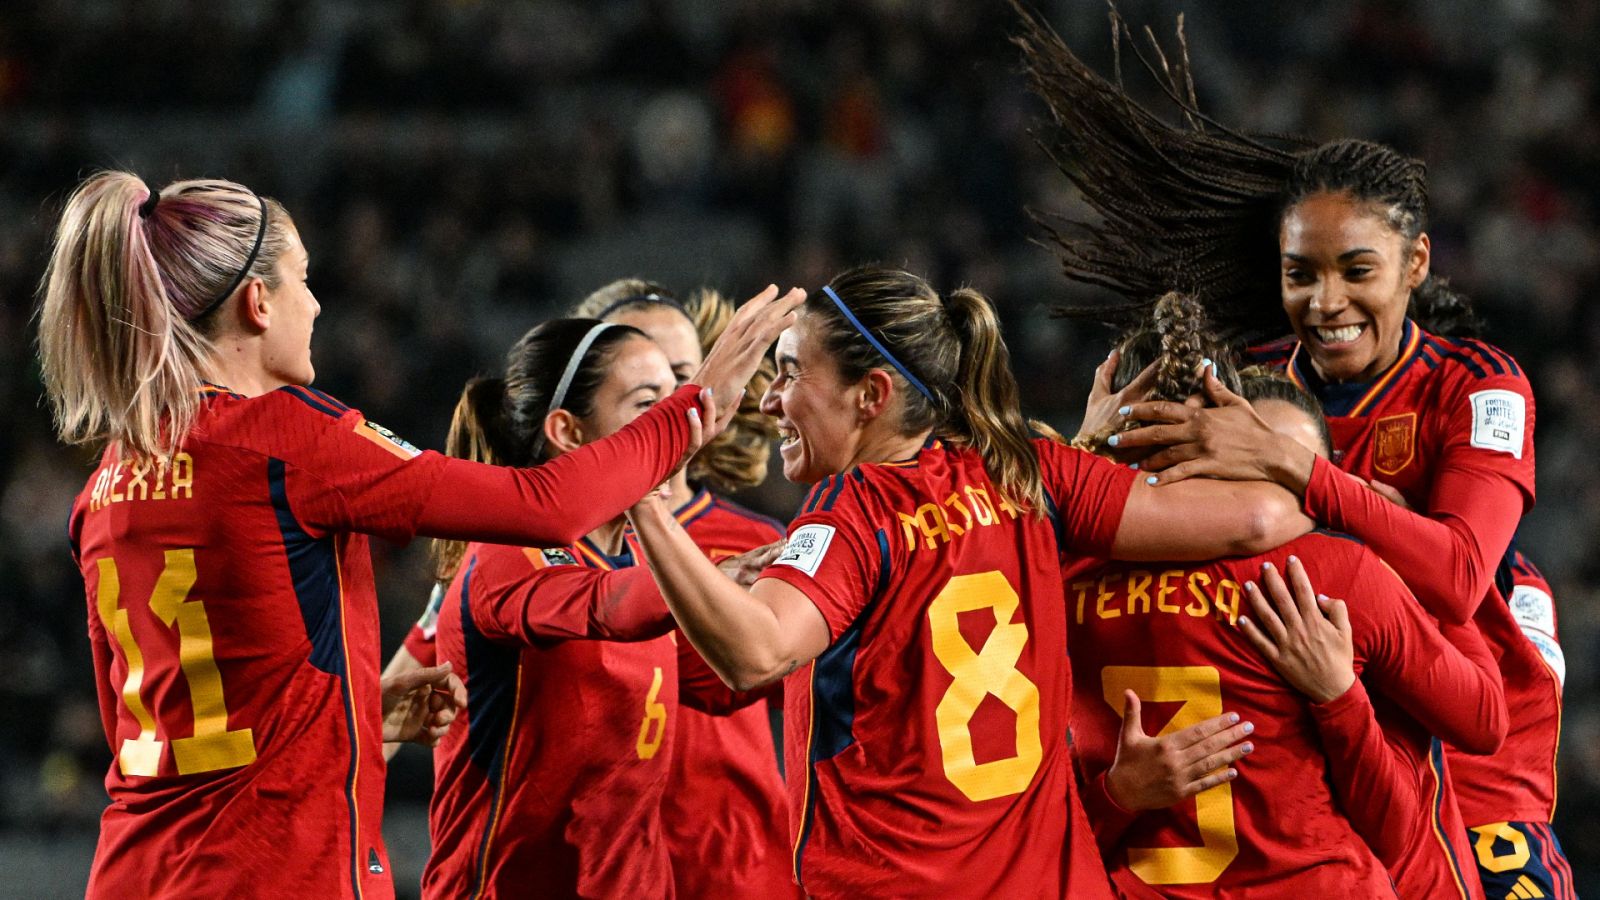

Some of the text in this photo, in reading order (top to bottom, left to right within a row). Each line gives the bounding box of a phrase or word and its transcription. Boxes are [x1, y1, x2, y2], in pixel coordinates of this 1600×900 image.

[1485, 399, 1514, 408] FOOTBAL
[1486, 407, 1516, 420] UNITE
[89, 452, 193, 512] ALEXIA
[1073, 569, 1240, 626] TERESA
[96, 548, 257, 777] 11
[928, 570, 1044, 802] 8
[636, 667, 666, 760] 6
[1101, 665, 1240, 885] 3
